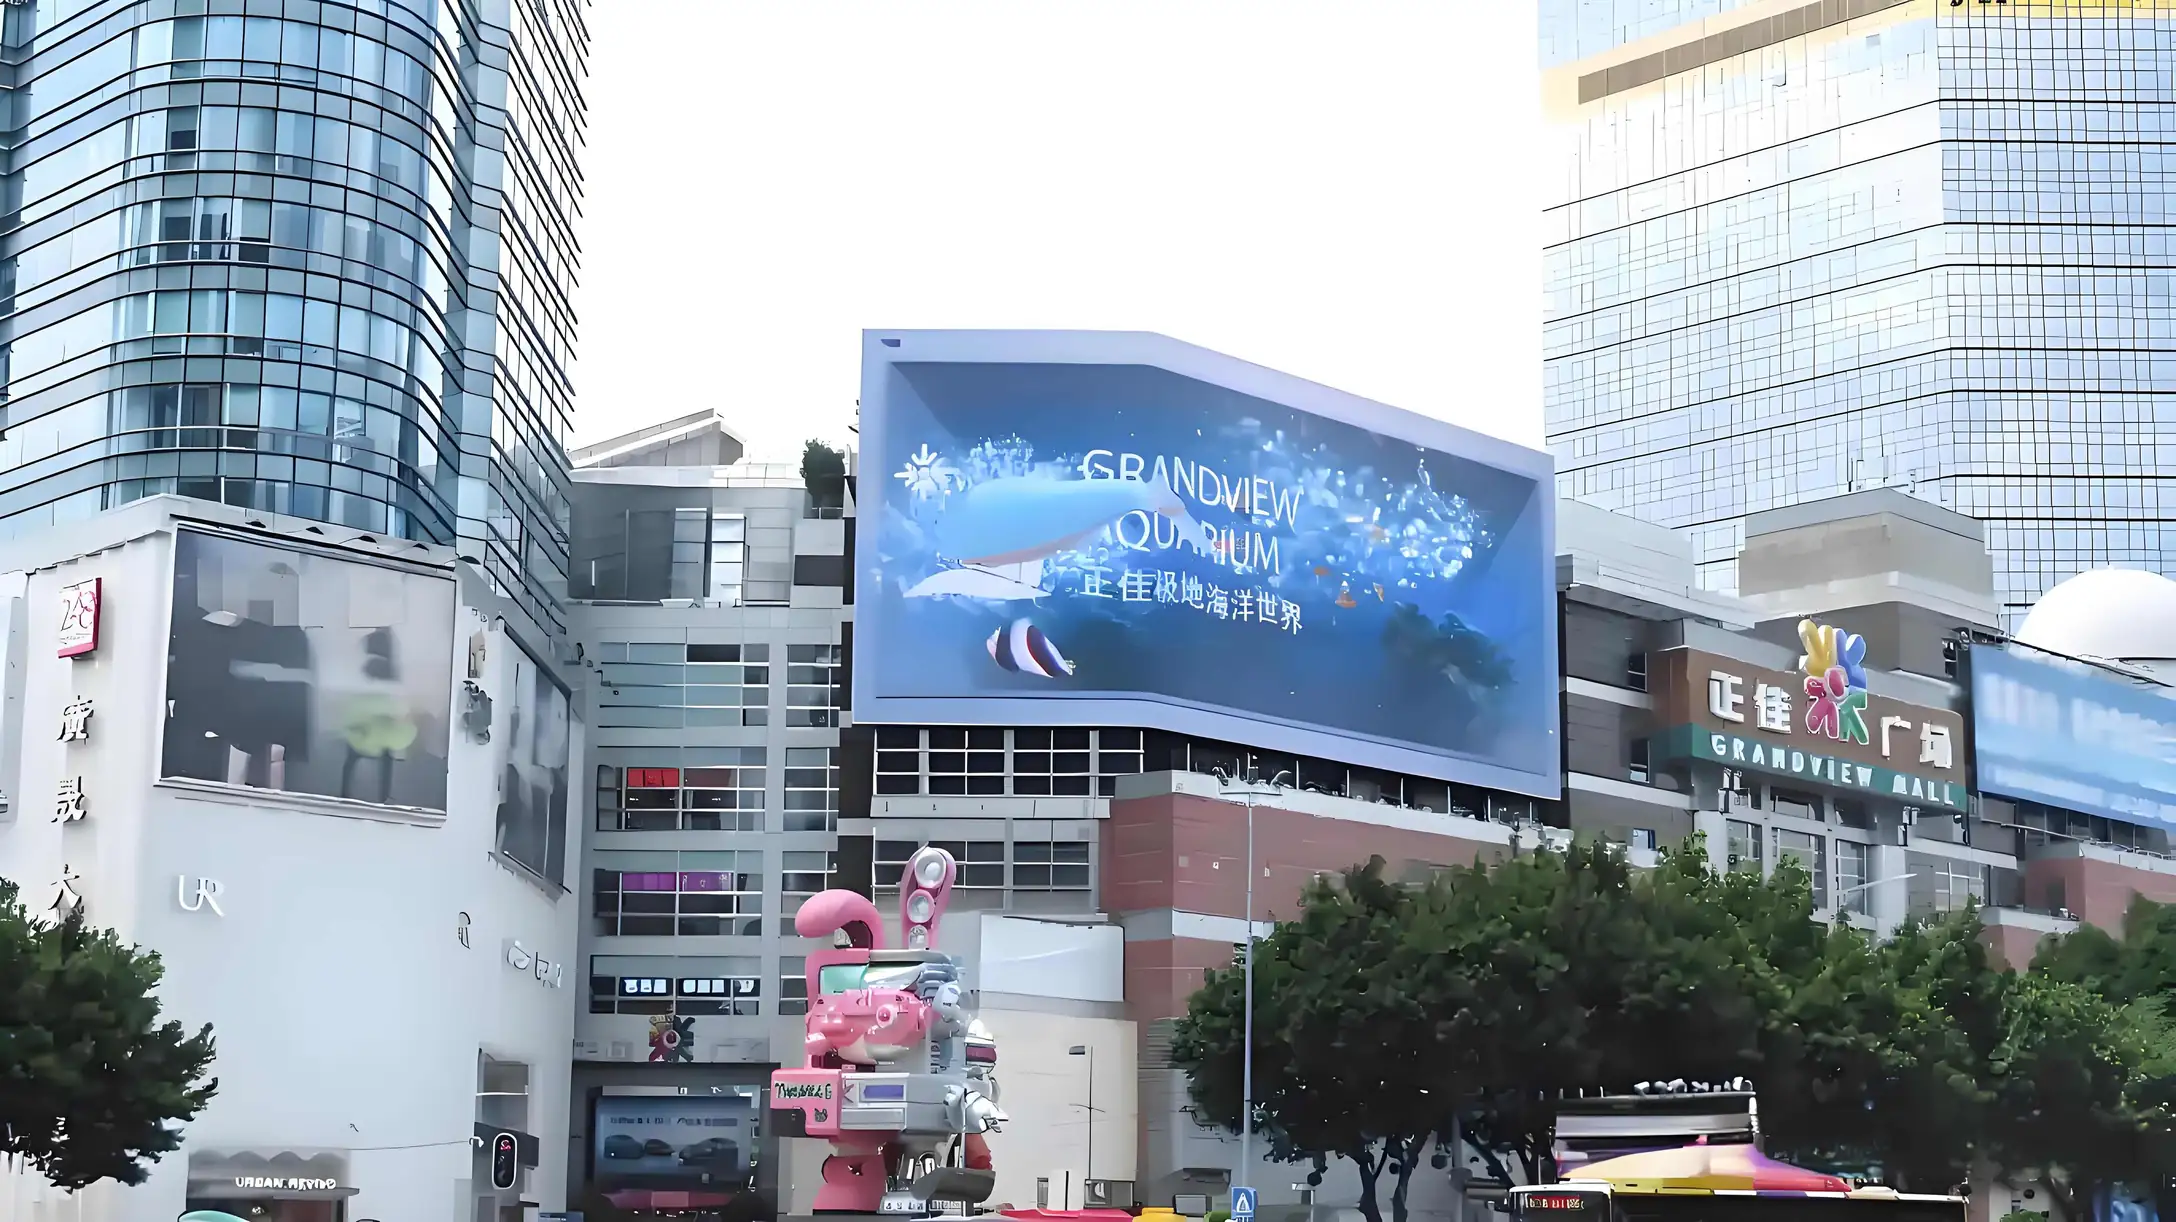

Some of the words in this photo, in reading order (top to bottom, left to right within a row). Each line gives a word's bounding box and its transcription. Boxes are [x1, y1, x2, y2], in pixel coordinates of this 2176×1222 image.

[1078, 448, 1305, 534] GRANDVIEW
[1104, 508, 1281, 576] QURIUM
[1078, 566, 1304, 636] 正佳极地海洋世界
[1710, 732, 1874, 788] GRANDVIEW
[1891, 773, 1955, 807] MALL
